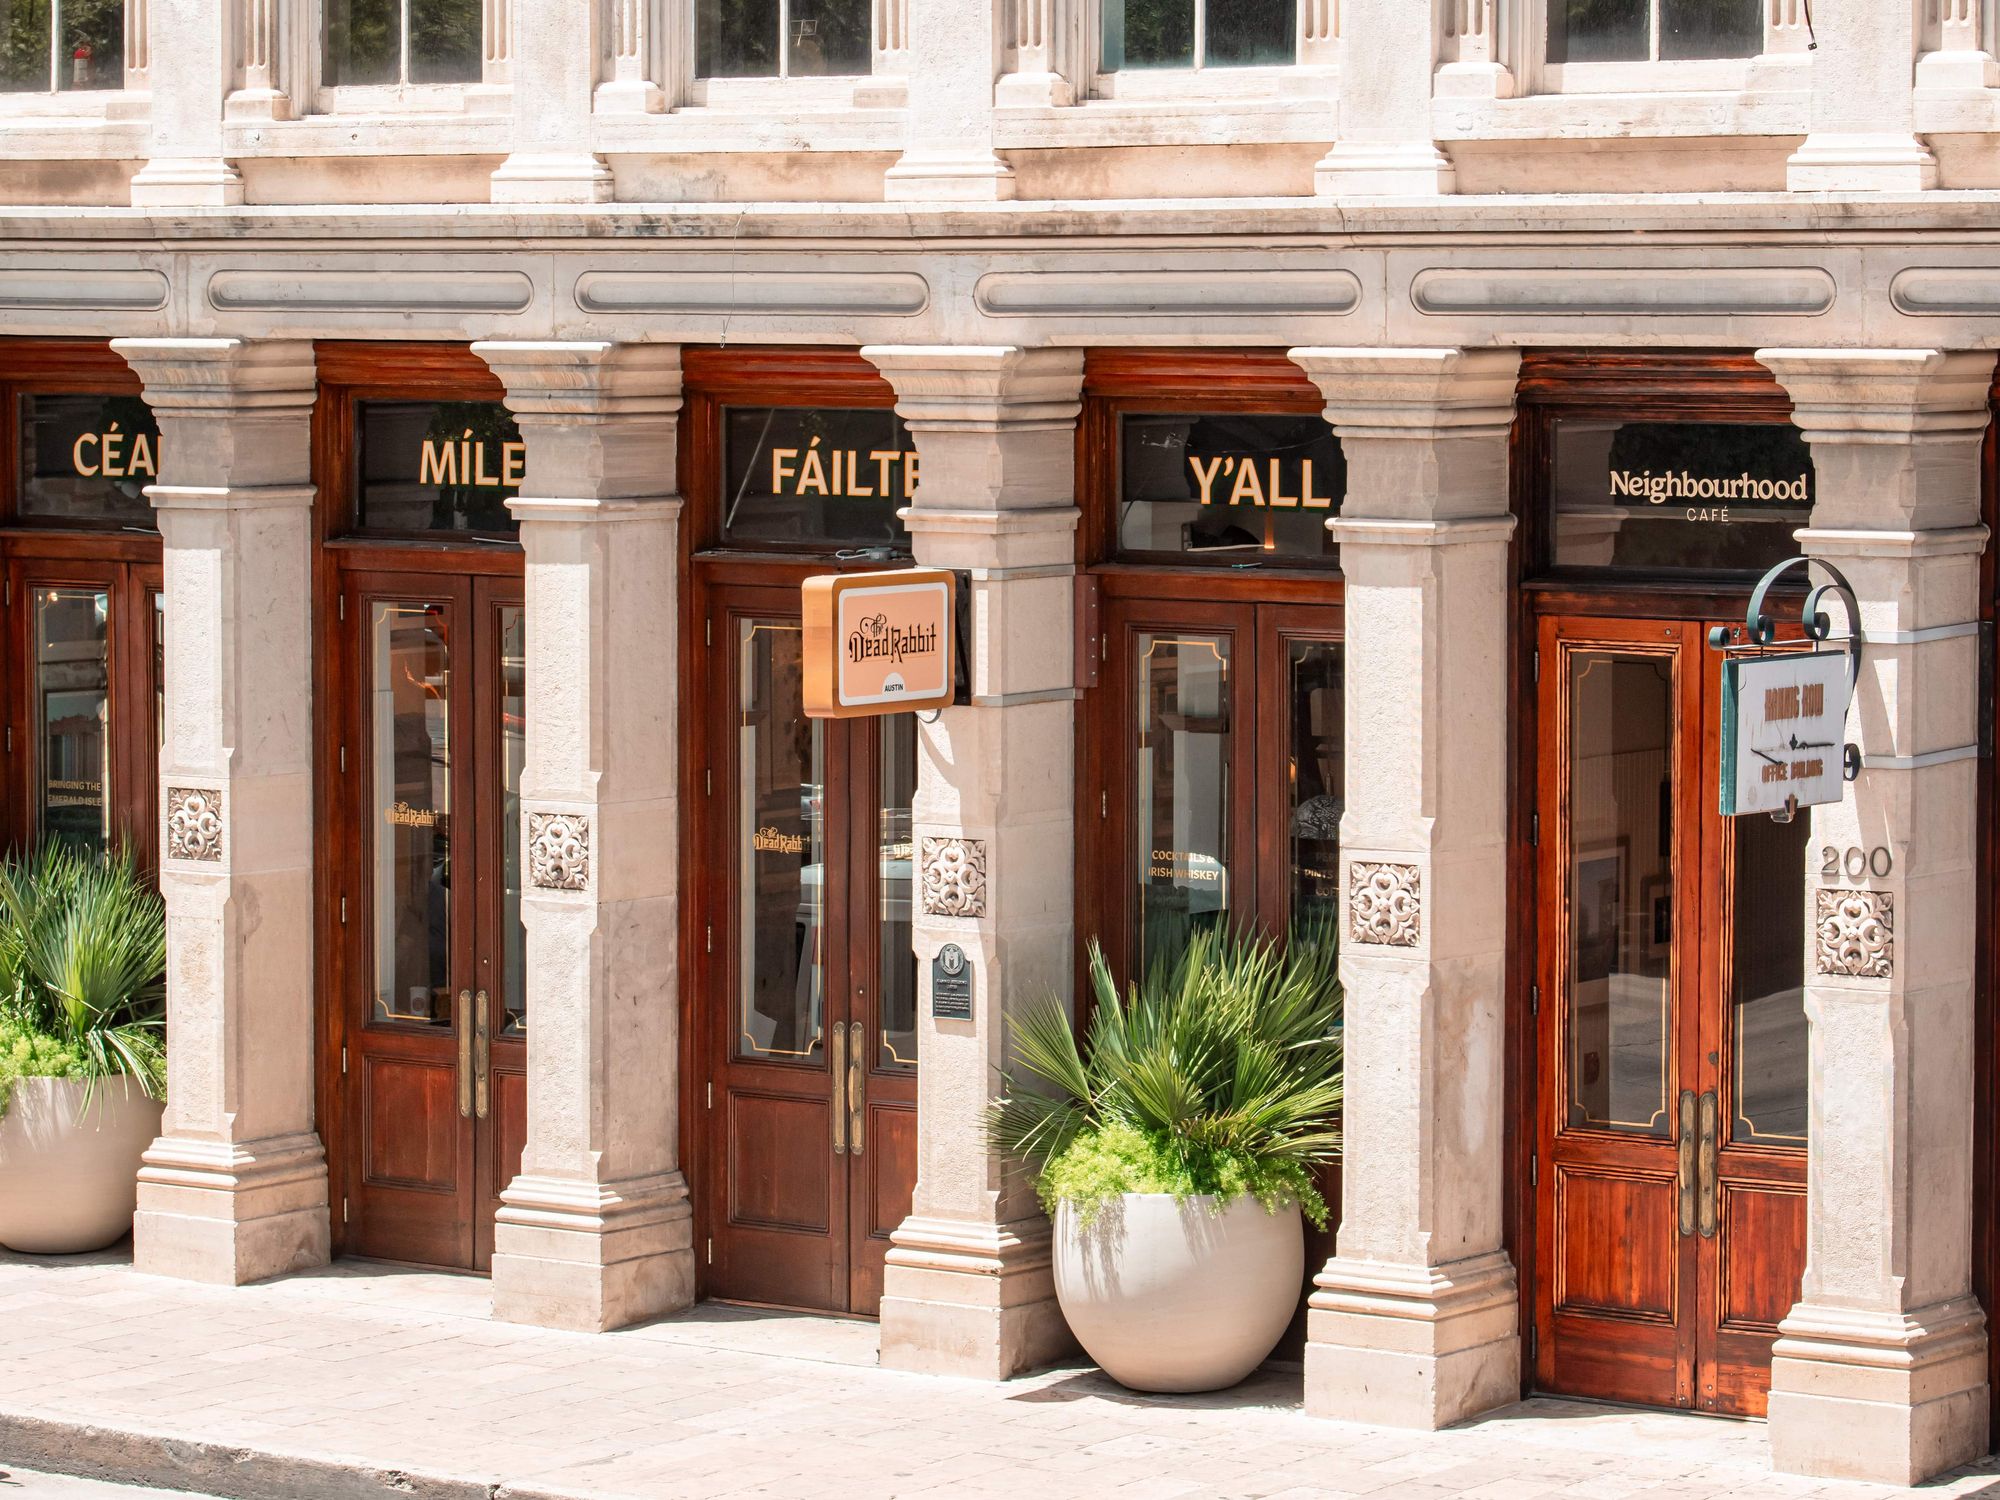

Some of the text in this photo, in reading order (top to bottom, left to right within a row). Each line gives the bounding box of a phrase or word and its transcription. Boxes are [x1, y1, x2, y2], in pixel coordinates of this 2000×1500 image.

[73, 421, 161, 477] CÉA
[420, 428, 526, 487] MÍLE
[772, 435, 921, 498] FÁILTE
[1609, 470, 1808, 504] Neighbourhood
[1686, 506, 1729, 523] CAFÉ
[849, 621, 937, 664] Dead Rabbit
[884, 683, 904, 693] AUSTIN
[1761, 762, 1788, 783] OFFICE
[86, 782, 102, 792] THE
[84, 797, 102, 807] ISLE
[1152, 850, 1206, 864] COCKTAILS
[1821, 846, 1893, 877] 200
[1148, 867, 1219, 881] IRISH WHISKEY
